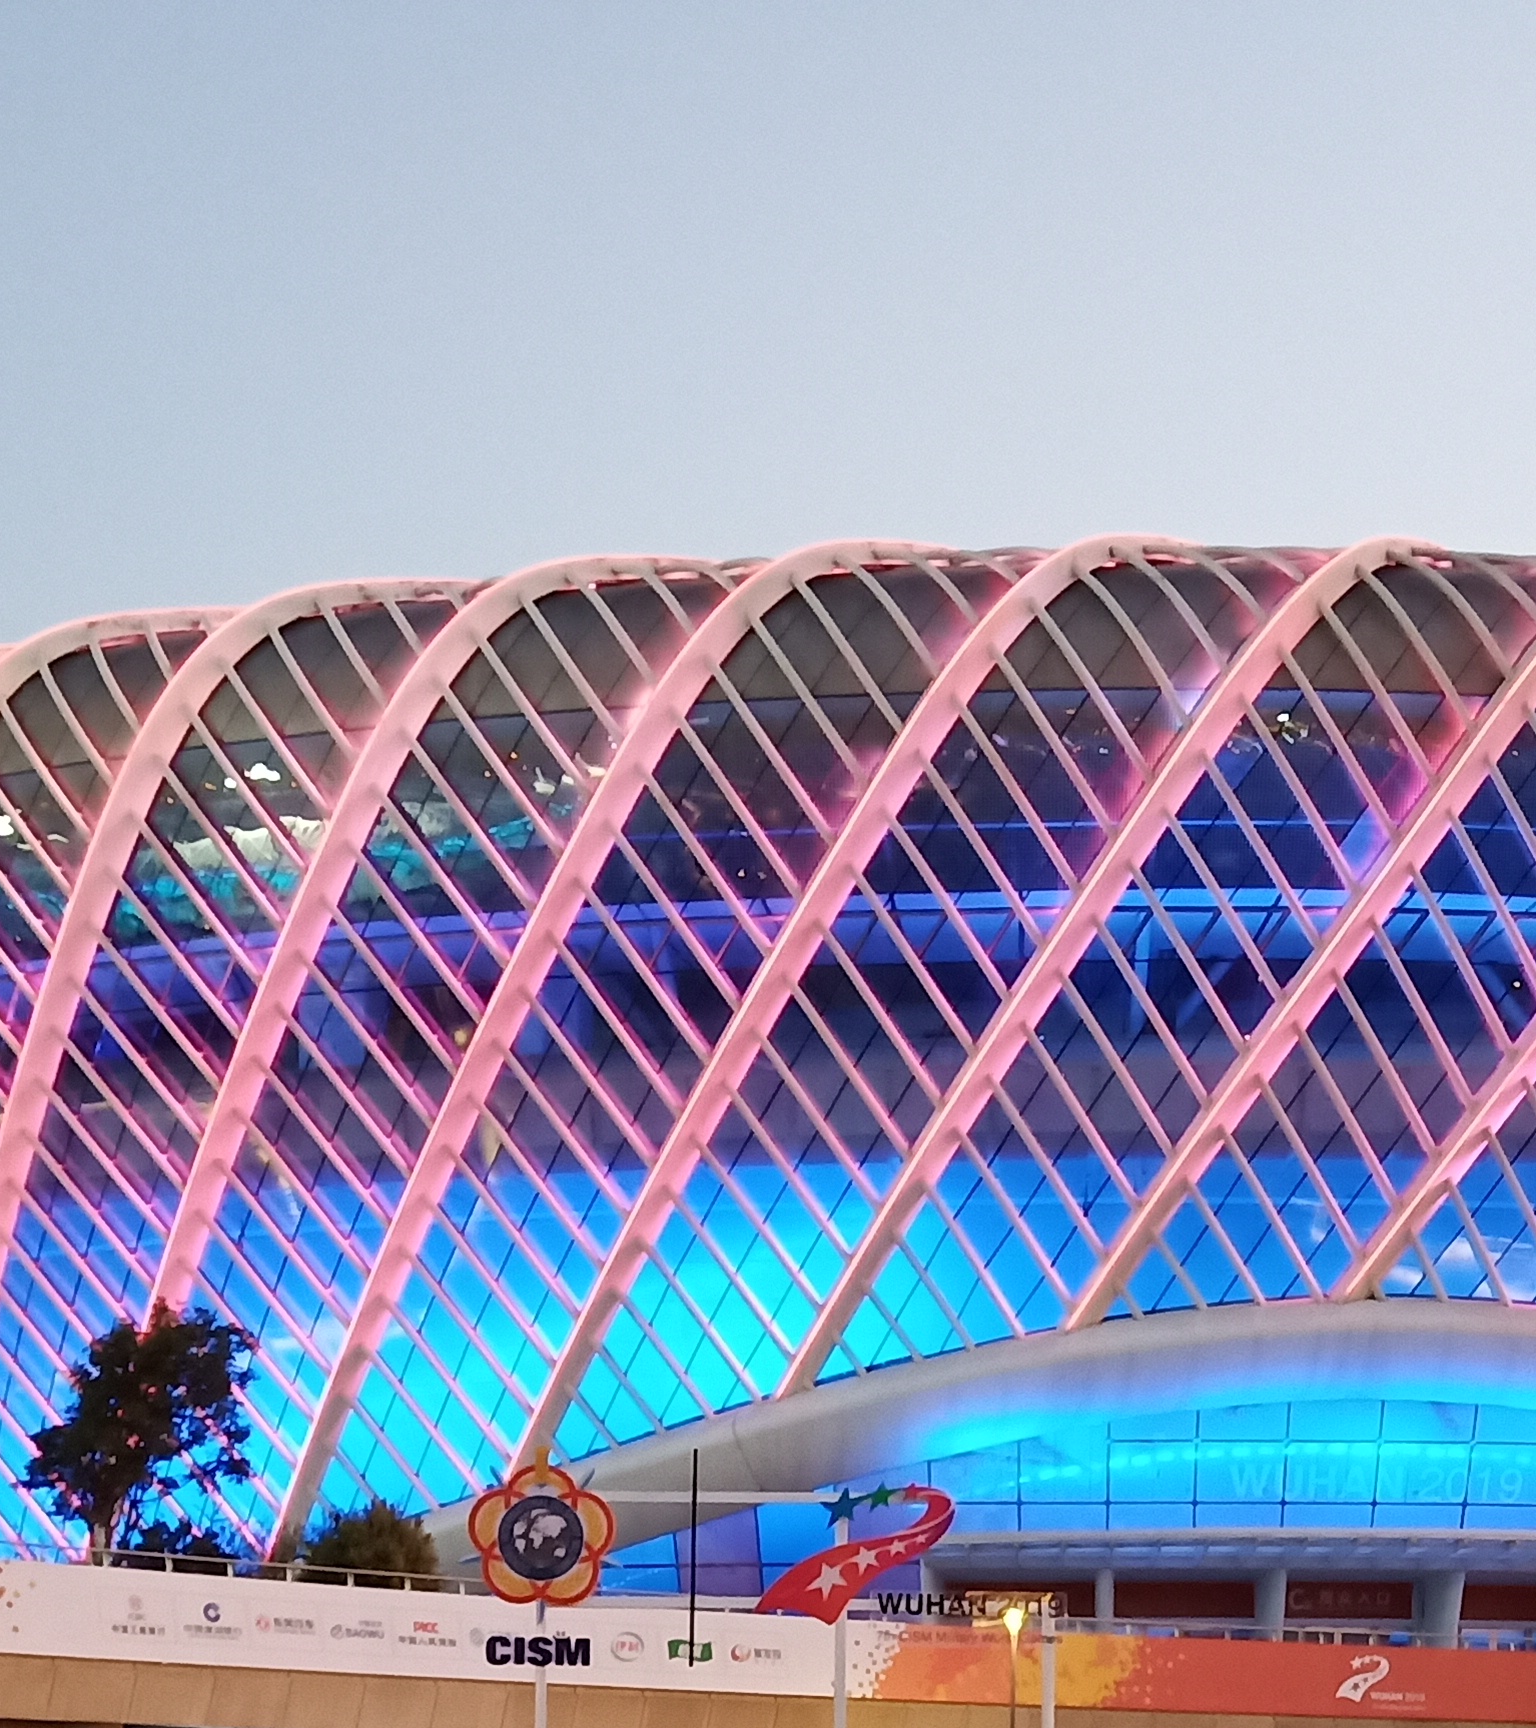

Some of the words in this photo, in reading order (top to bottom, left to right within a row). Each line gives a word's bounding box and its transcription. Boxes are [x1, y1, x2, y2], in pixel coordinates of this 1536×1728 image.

[1230, 1463, 1405, 1499] WUHAN
[1420, 1466, 1522, 1503] 2019
[486, 1636, 590, 1667] CISM
